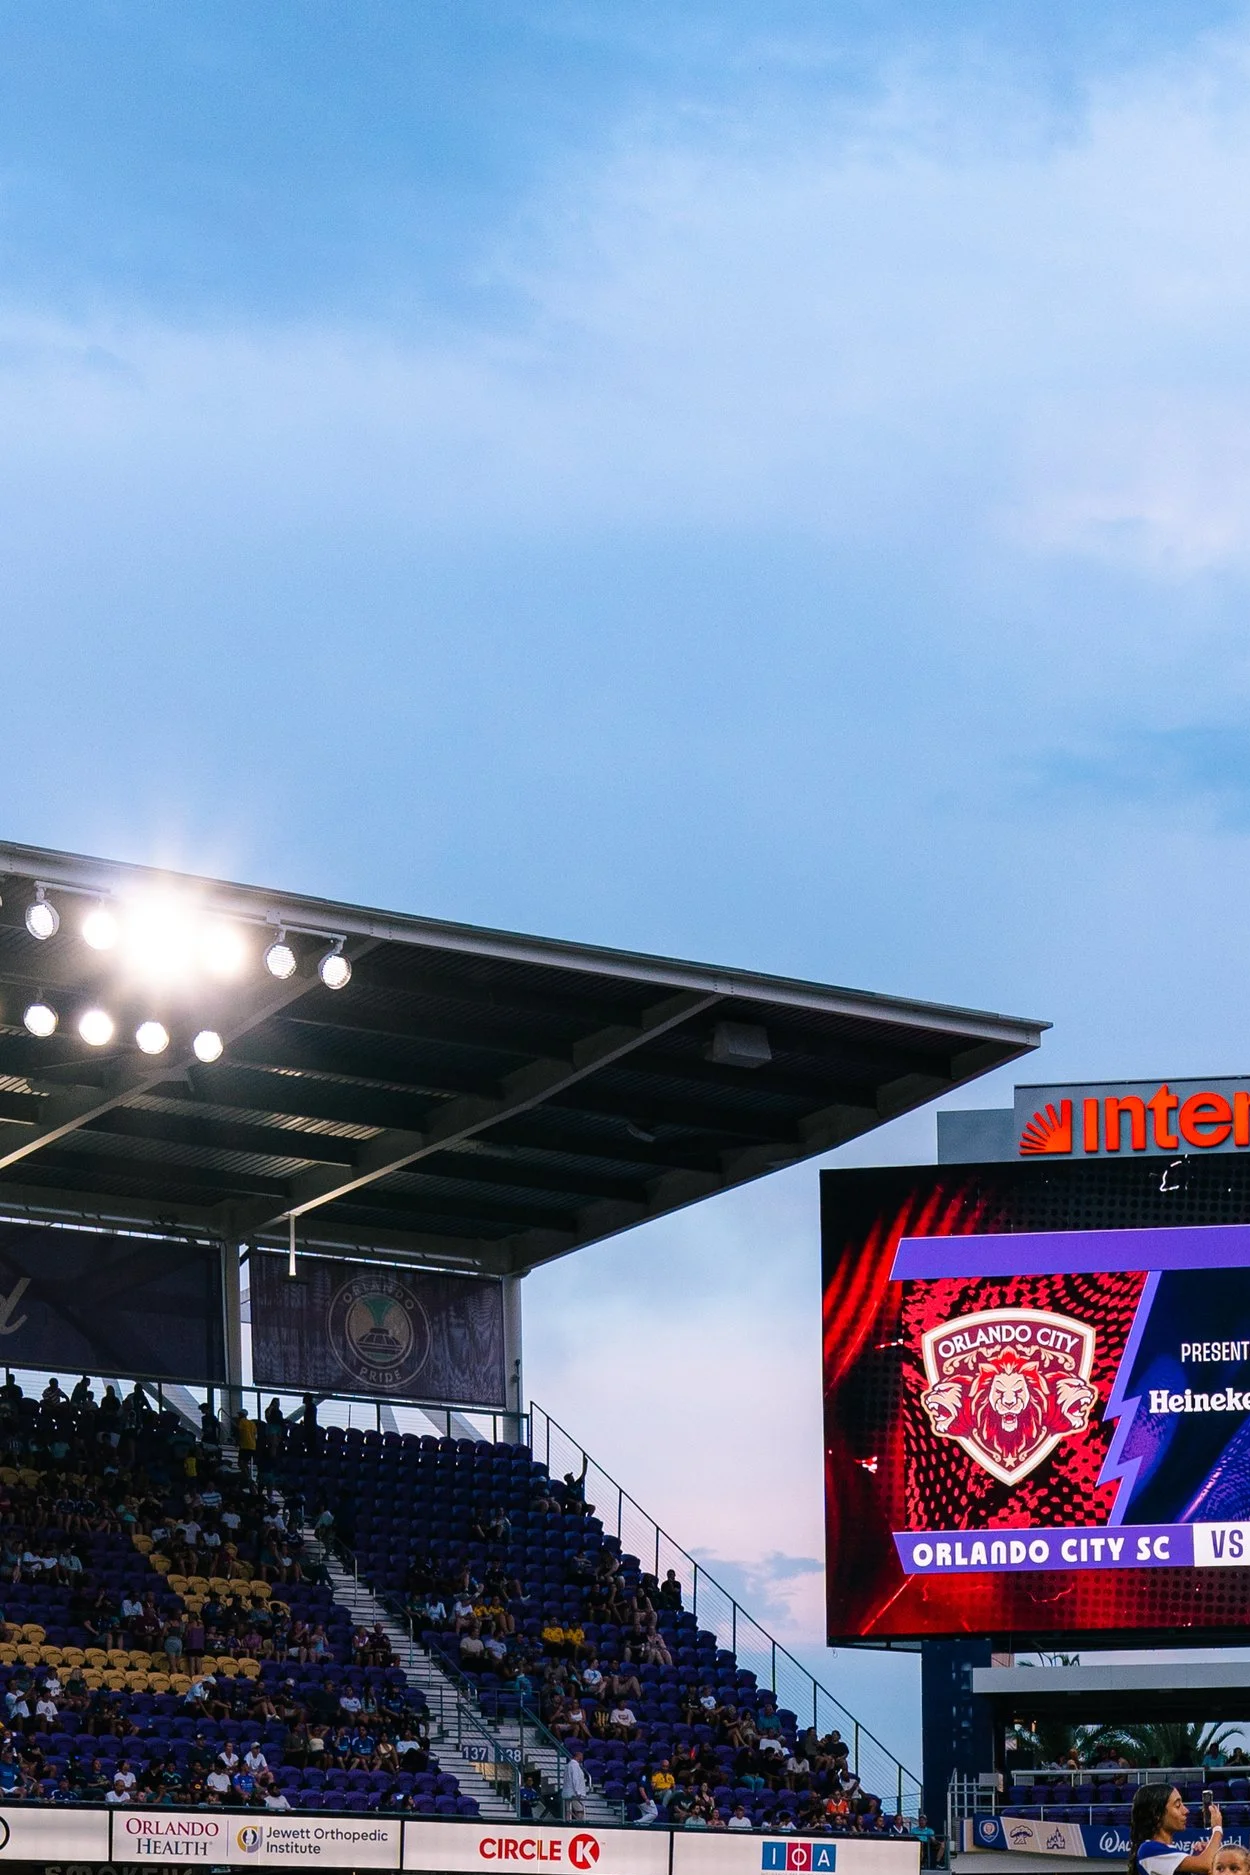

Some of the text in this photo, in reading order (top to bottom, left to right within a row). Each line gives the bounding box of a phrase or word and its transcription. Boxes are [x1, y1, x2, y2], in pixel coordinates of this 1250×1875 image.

[343, 1281, 414, 1310] ORLANDO
[938, 1325, 1079, 1358] ORLANDO CITY
[360, 1366, 402, 1383] PRIDE
[912, 1539, 1050, 1567] ORLANDO
[1061, 1536, 1125, 1562] CITY
[1136, 1535, 1170, 1561] SC
[1211, 1530, 1244, 1558] VS
[463, 1746, 487, 1761] 137
[126, 1818, 219, 1837] ORLANDO
[266, 1826, 388, 1843] Jewett Orthopedic
[136, 1838, 207, 1856] HEALTH
[266, 1841, 321, 1855] Institute
[479, 1837, 562, 1861] CIRCLE
